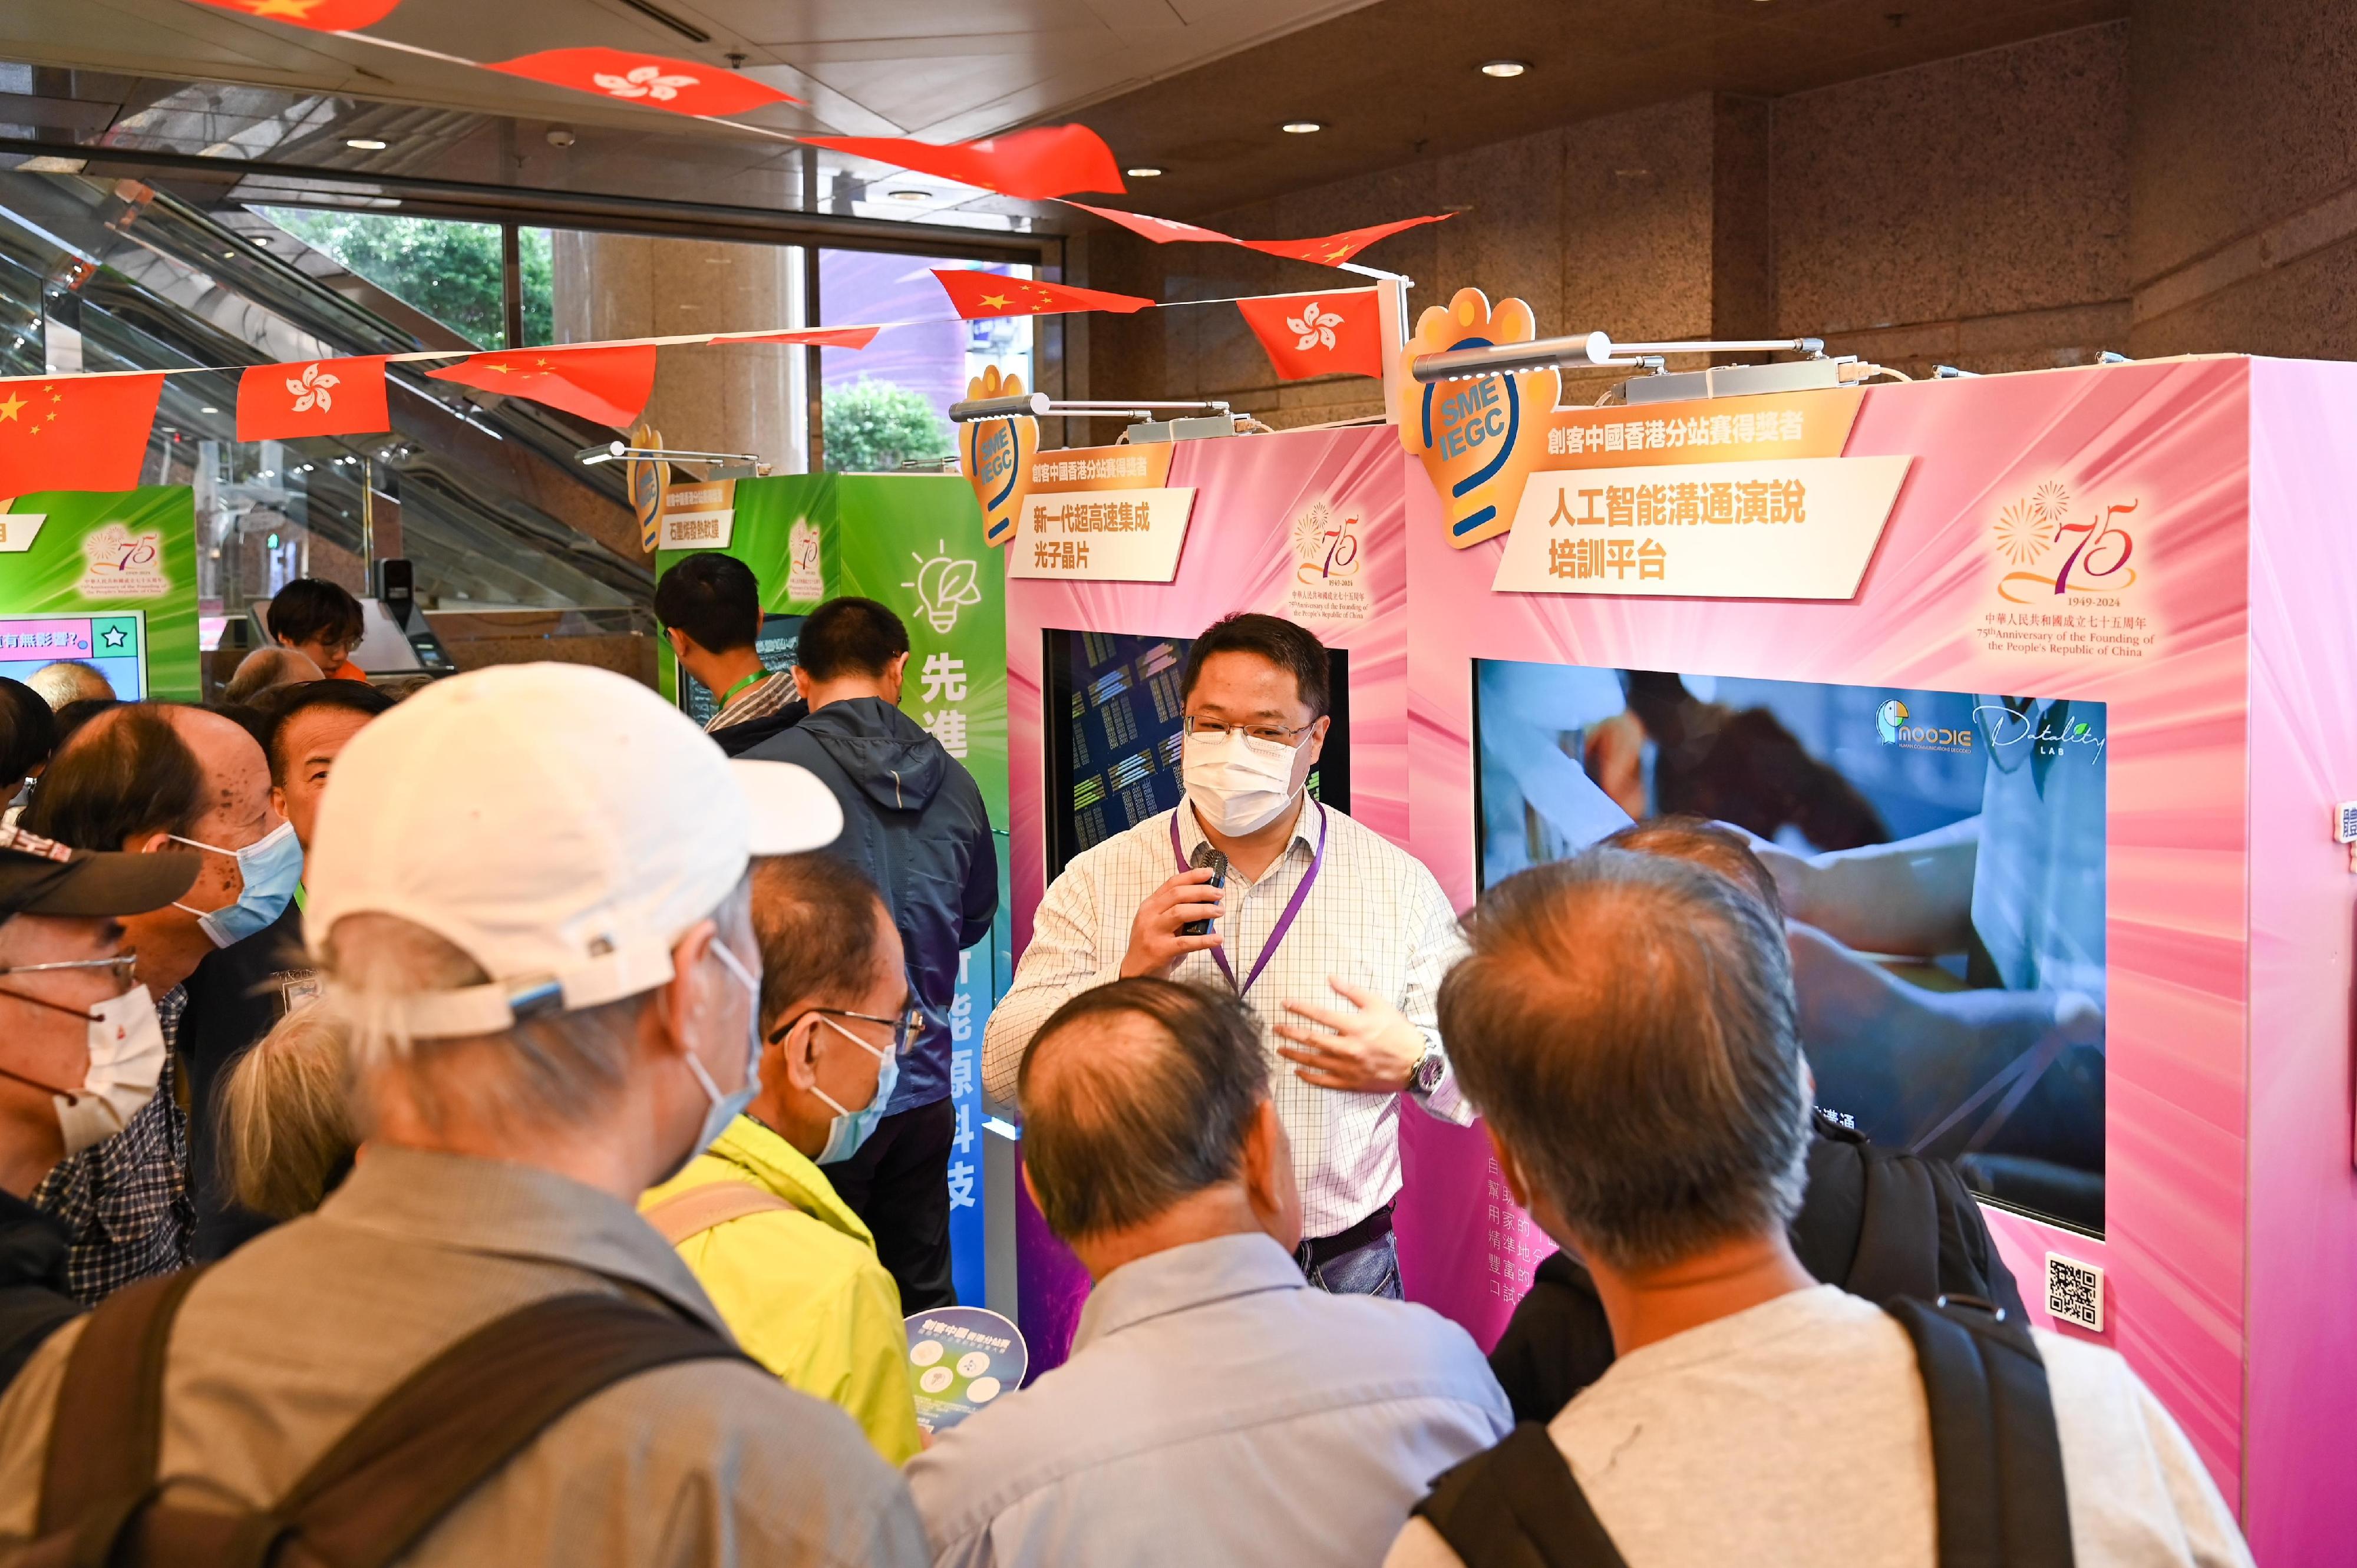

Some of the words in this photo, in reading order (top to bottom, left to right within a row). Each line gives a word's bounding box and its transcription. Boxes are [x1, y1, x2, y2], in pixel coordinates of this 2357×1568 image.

[1441, 377, 1500, 427] SME
[981, 426, 1009, 460] SME
[1439, 408, 1504, 462] IEGC
[1547, 410, 1803, 455] 創客中國香港分站賽得獎者
[981, 450, 1012, 486] IEGC
[1032, 457, 1147, 483] 創客中國香港分站賽得獎者
[1034, 501, 1150, 533] 新一代超高速集成
[1549, 479, 1805, 527] 人工智能溝通演說
[118, 533, 157, 571] 75
[1034, 541, 1090, 569] 光子晶片
[1322, 514, 1358, 578] 75
[1549, 538, 1666, 580] 培訓平台
[2054, 499, 2138, 595] 75
[1339, 603, 1362, 612] Founding
[2068, 597, 2121, 607] 1949-2024
[1985, 612, 2147, 630] 中華人民共和國成立七十五周年
[1988, 641, 2003, 651] the
[2007, 642, 2046, 653] People's
[2050, 644, 2094, 655] Republic
[2098, 646, 2108, 655] of
[2112, 646, 2143, 657] China
[2056, 631, 2067, 641] of
[2070, 632, 2085, 642] the
[2090, 633, 2139, 646] Founding
[2143, 634, 2155, 645] of
[2040, 745, 2065, 756] LAB
[1814, 1105, 1855, 1130] 溝通
[1488, 1156, 1498, 1176] 自
[1488, 1180, 1514, 1206] 幫助
[1489, 1253, 1534, 1288] 豐富的
